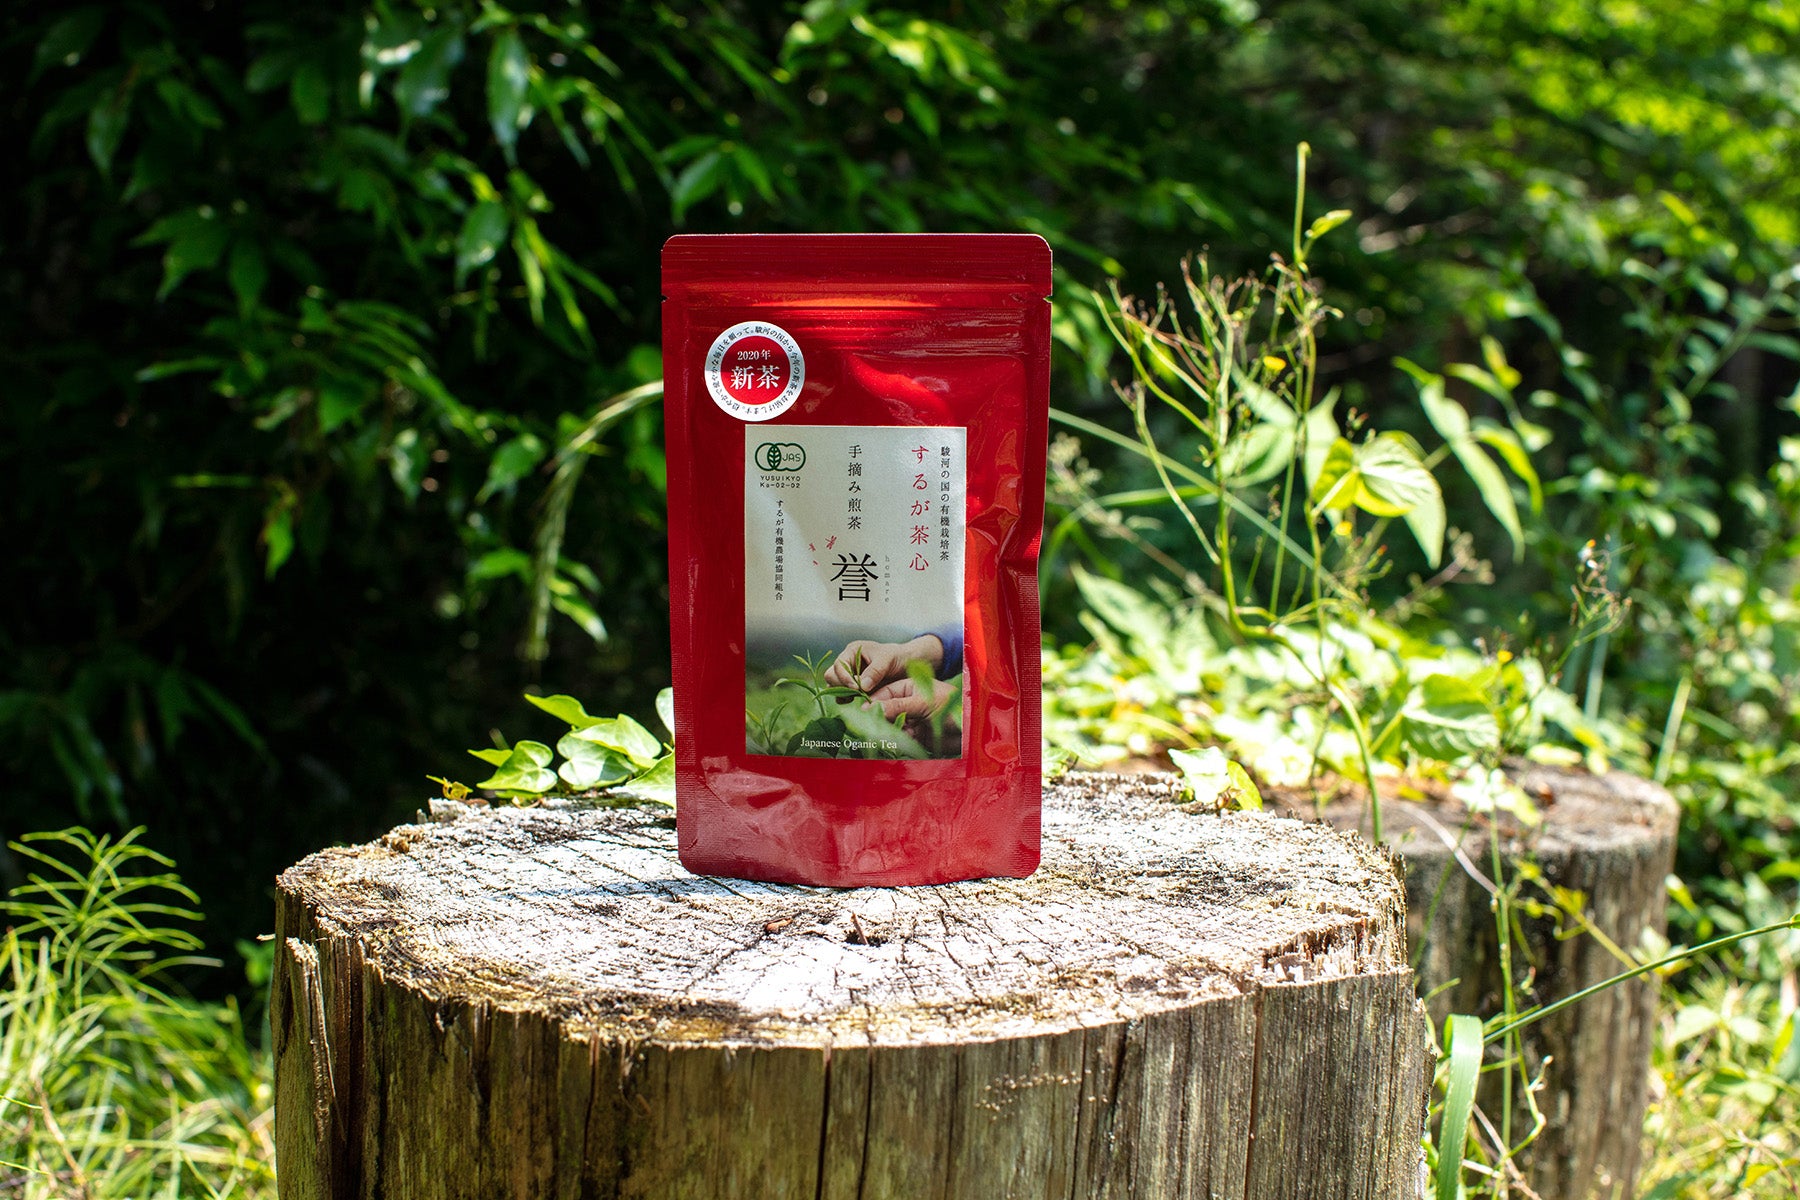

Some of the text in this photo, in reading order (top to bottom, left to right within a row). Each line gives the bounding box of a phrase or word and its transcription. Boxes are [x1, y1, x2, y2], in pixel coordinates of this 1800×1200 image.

[730, 364, 781, 390] 新茶
[737, 349, 771, 361] 2020年
[782, 453, 801, 462] JAS
[847, 444, 862, 530] 手摘み煎茶
[909, 445, 931, 571] するが茶心
[940, 446, 951, 561] 駿河の国の有機栽培茶
[775, 500, 784, 601] するが有機農場協同組合
[830, 552, 879, 602] 誉
[800, 738, 898, 750] Japanese Oganic Tea
